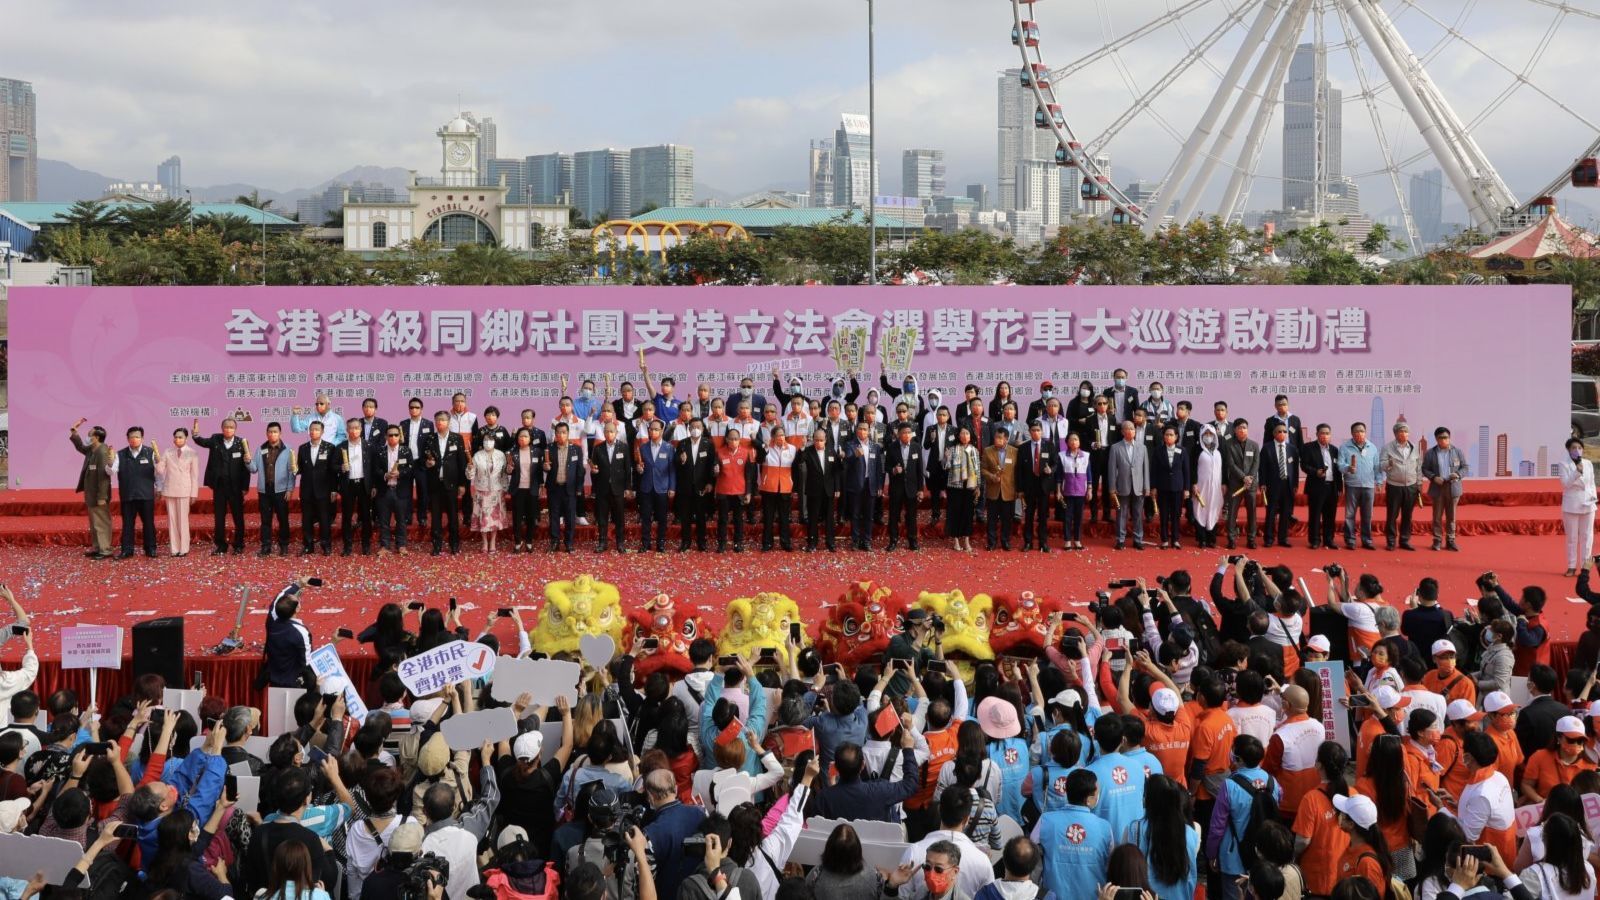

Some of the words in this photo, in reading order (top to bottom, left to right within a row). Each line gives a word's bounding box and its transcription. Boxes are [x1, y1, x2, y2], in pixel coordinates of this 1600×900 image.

[224, 307, 1367, 352] 全港省級同鄉社團支持立法會選舉花車大巡遊啟動禮
[227, 373, 308, 383] 香港廣東社團總會
[315, 372, 395, 382] 香港福建社團聯會
[403, 372, 482, 382] 香港廣西社團總會
[1051, 370, 1115, 380] 香港湖南聯誼
[1249, 369, 1327, 379] 香港山東社團總會
[1335, 369, 1412, 379] 香港四川社團總會
[227, 388, 297, 398] 香港天津聯誼會
[401, 643, 467, 679] 全港市民
[414, 665, 465, 695] 齊投票
